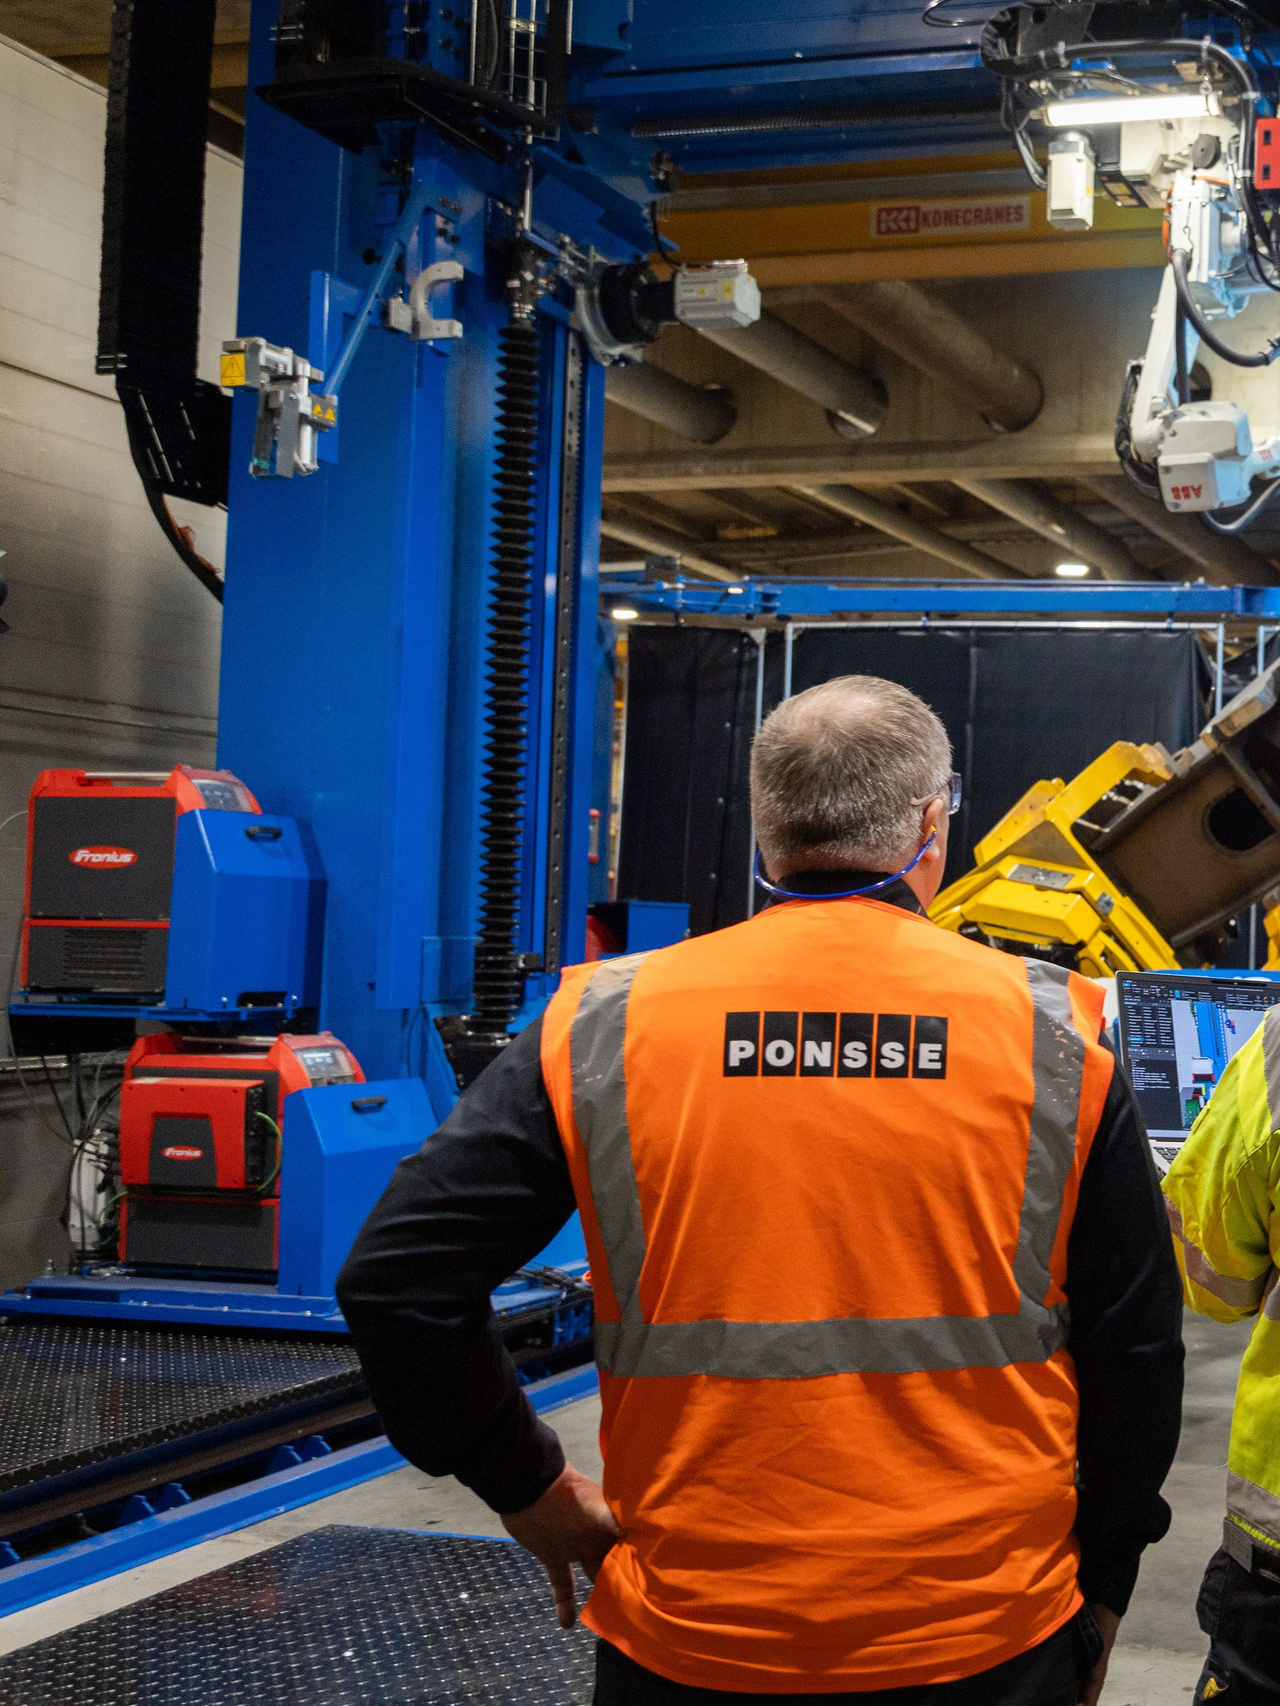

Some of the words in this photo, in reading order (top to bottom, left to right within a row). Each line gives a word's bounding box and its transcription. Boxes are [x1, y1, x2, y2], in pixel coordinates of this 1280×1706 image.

[921, 205, 1024, 228] KONECRANES
[1171, 485, 1202, 500] ABB
[74, 849, 134, 863] Fronius
[728, 1039, 942, 1069] PONSSE
[164, 1147, 201, 1157] Fronius
